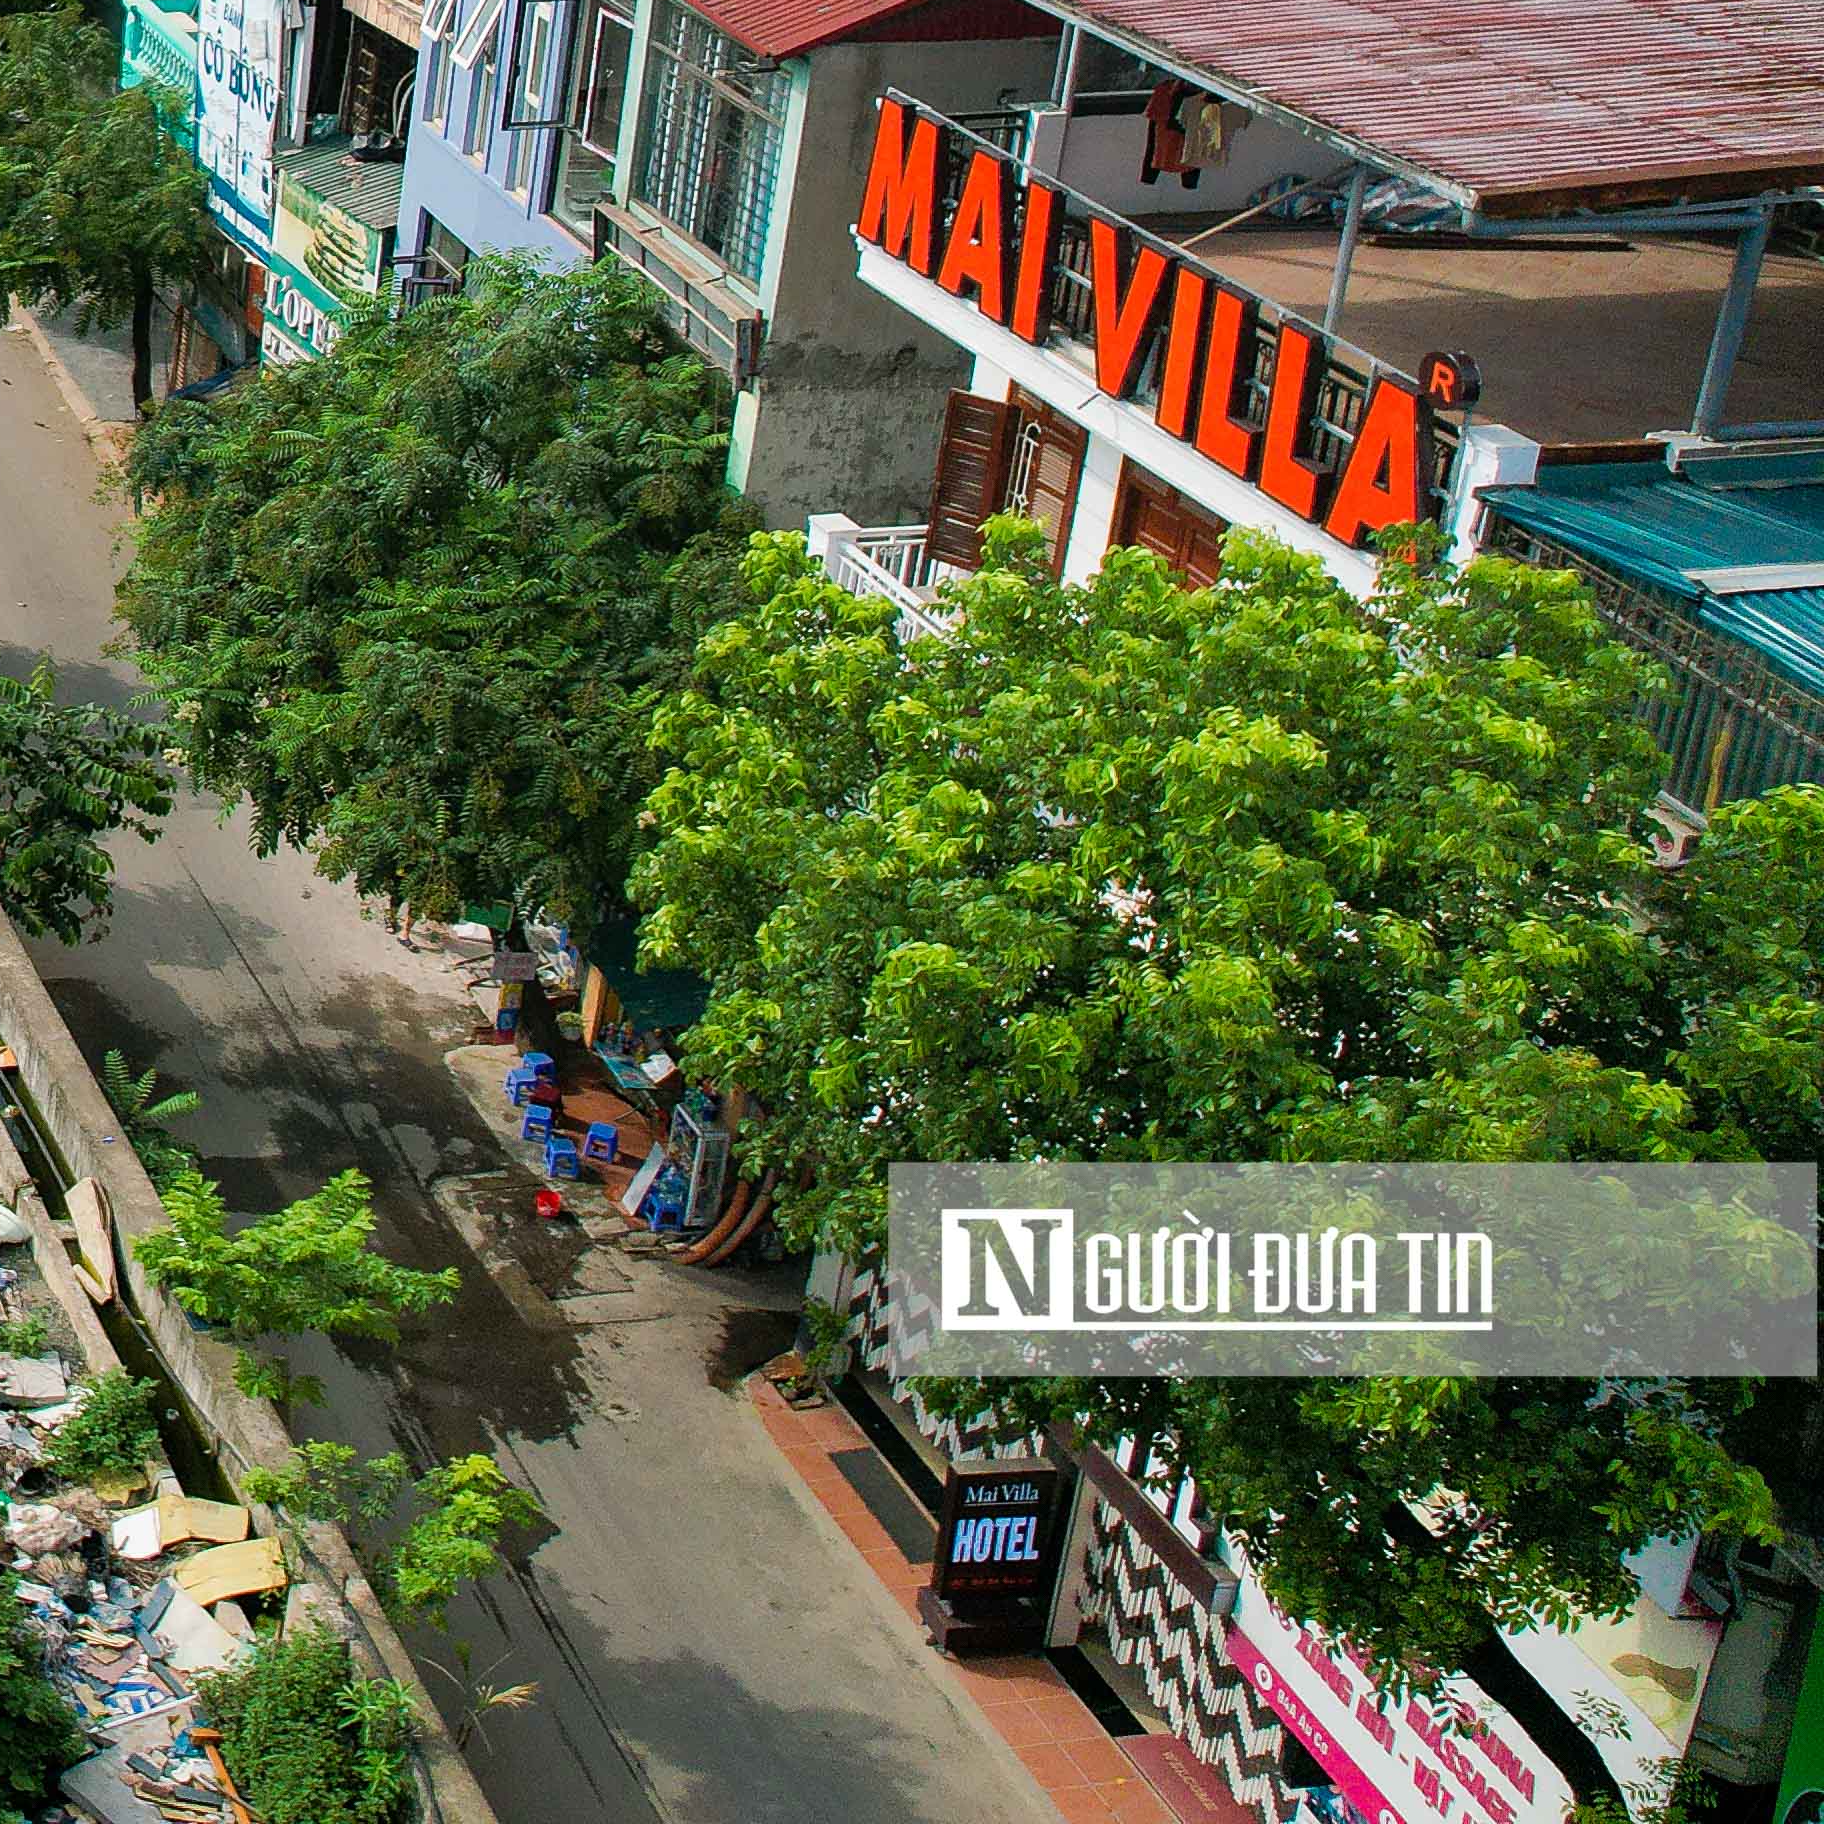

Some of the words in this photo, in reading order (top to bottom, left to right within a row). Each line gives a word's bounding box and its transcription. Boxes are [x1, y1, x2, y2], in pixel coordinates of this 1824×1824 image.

[203, 26, 224, 83] CÔ
[856, 94, 1053, 345] MAI
[1090, 216, 1418, 564] VILLA
[965, 1485, 998, 1504] Mai
[1002, 1482, 1040, 1502] Villa
[952, 1516, 1040, 1563] HOTEL
[1413, 1755, 1455, 1819] VẬT
